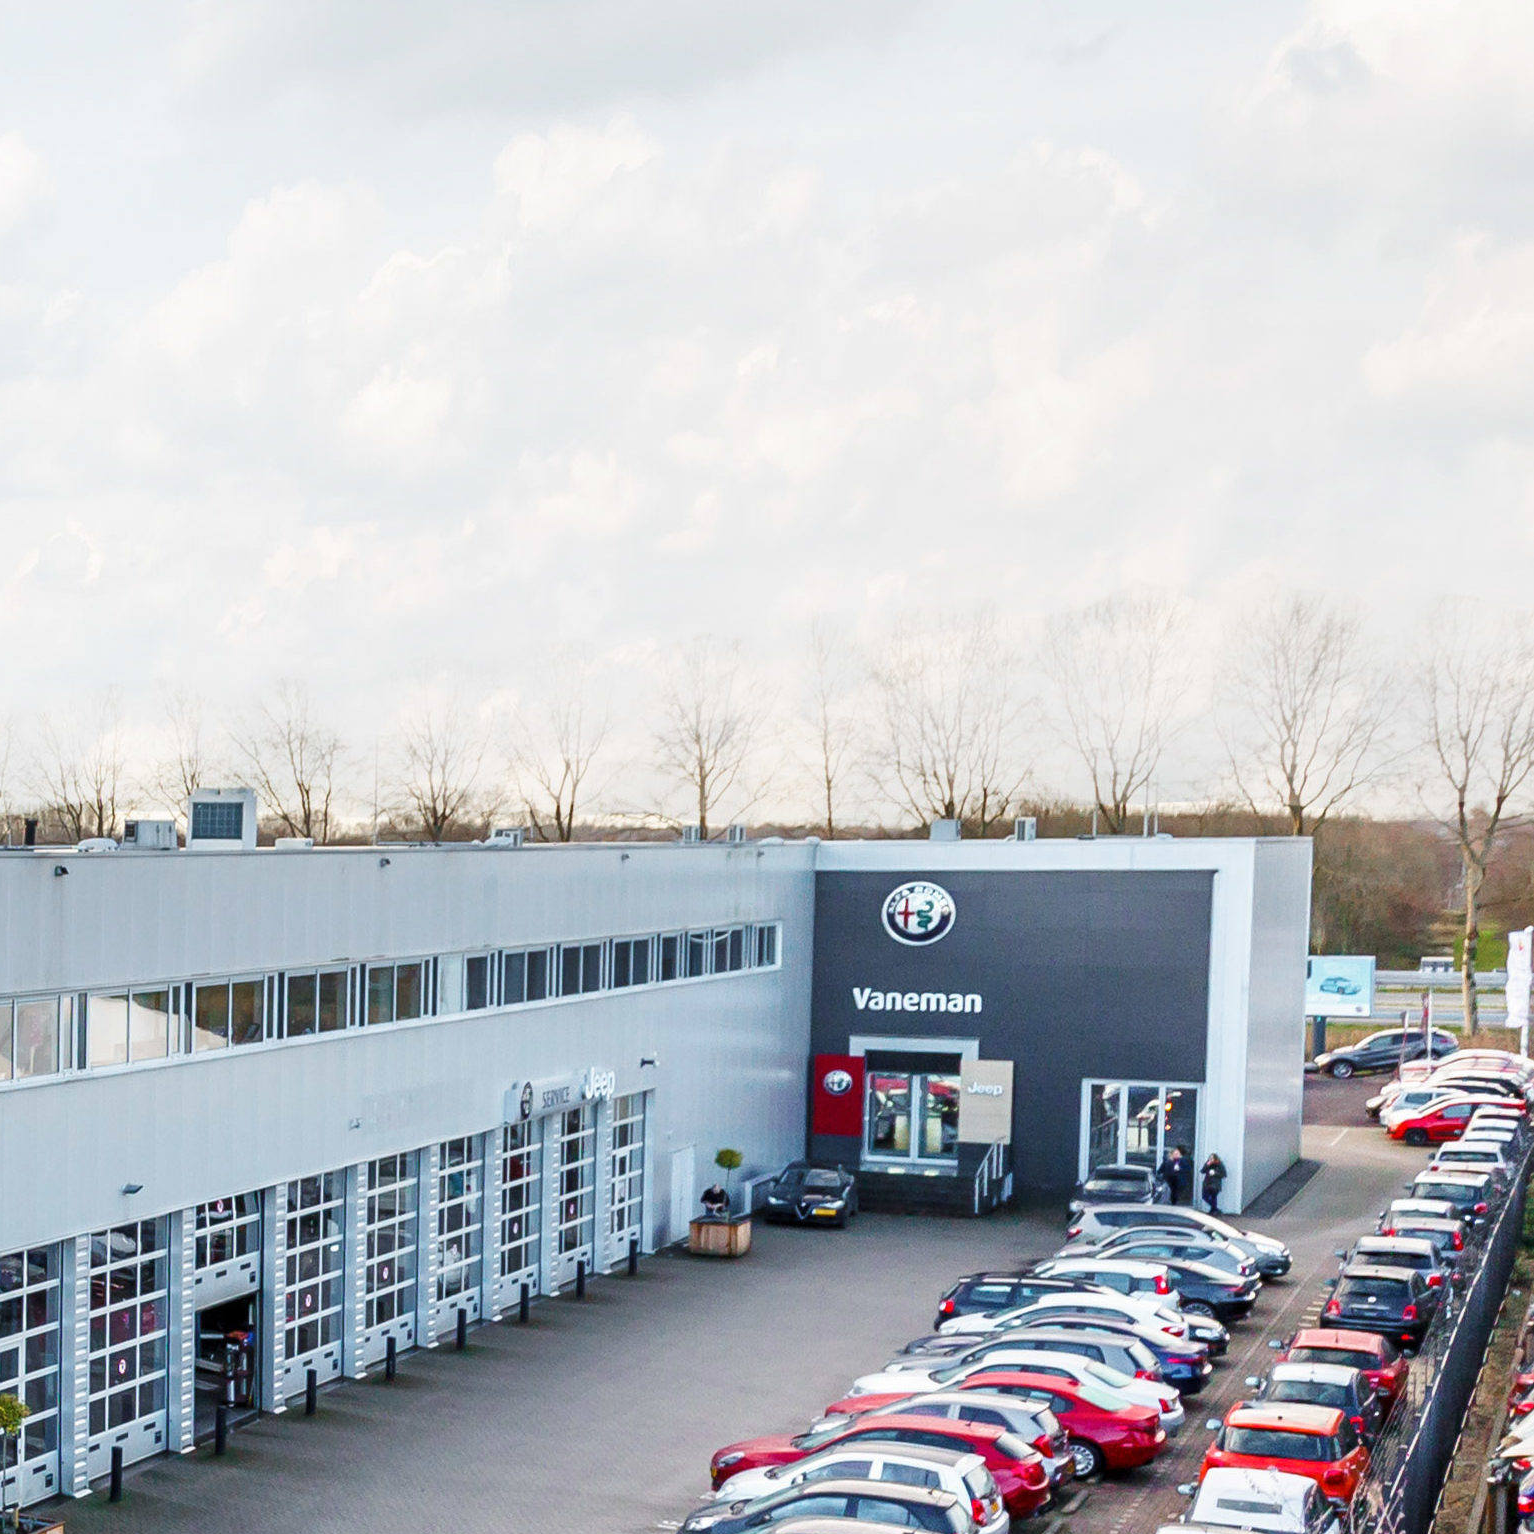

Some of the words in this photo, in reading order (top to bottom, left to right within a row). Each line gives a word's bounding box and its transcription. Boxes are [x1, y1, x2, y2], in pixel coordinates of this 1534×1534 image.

[852, 987, 983, 1014] Vaneman
[541, 1086, 571, 1109] SERVICE
[584, 1066, 615, 1101] Jeep
[967, 1081, 1004, 1097] Jeep
